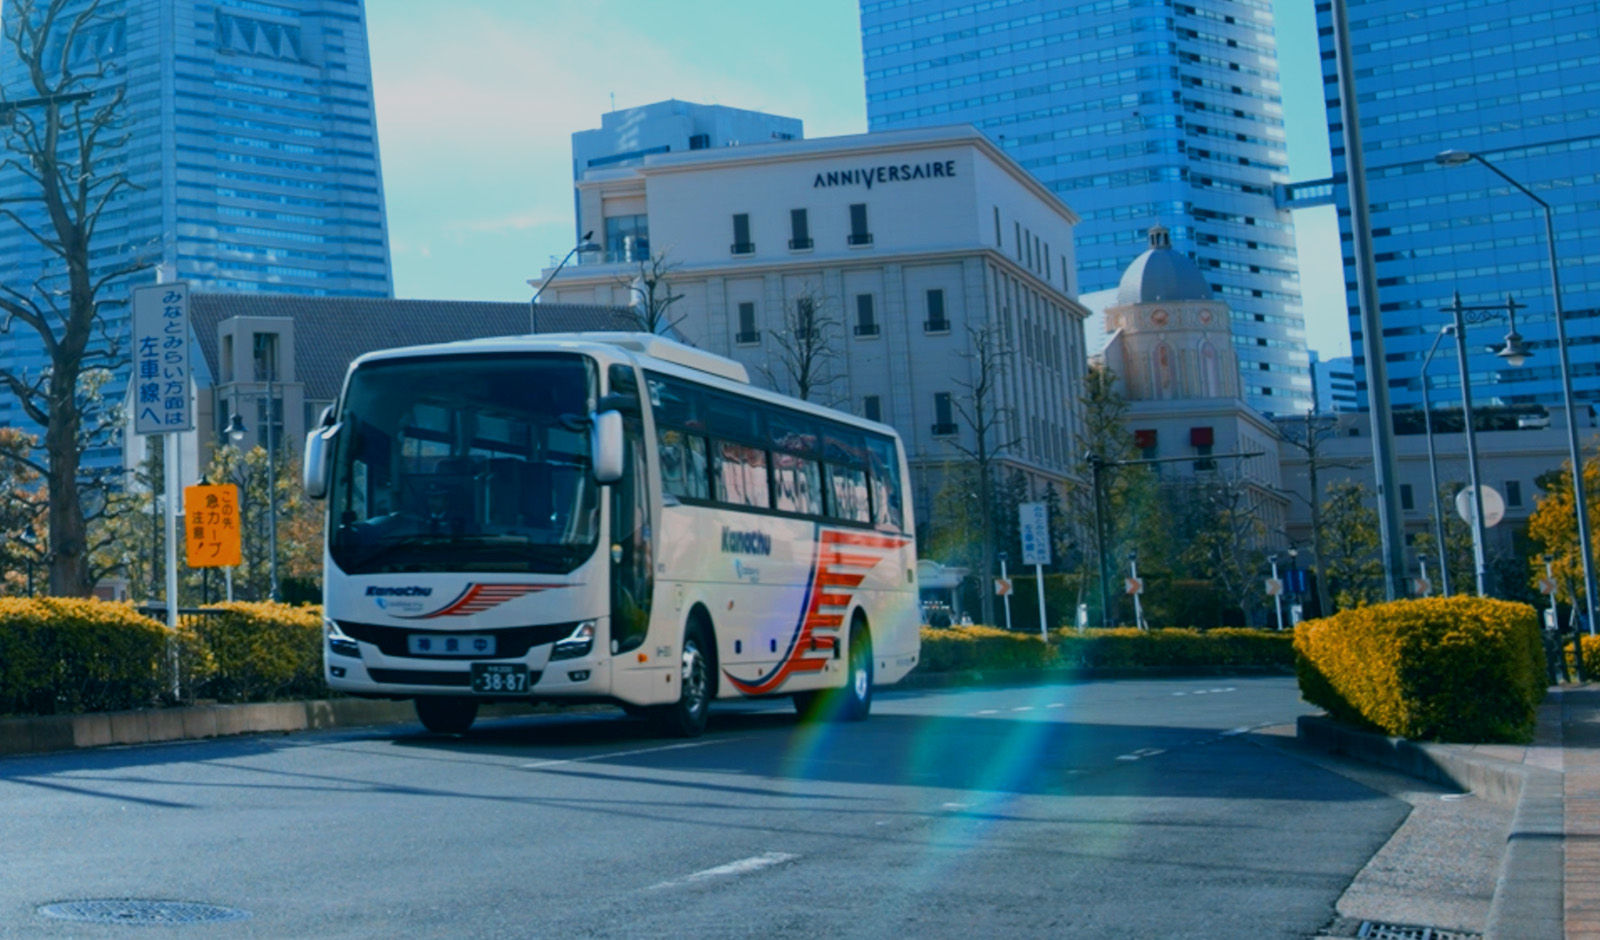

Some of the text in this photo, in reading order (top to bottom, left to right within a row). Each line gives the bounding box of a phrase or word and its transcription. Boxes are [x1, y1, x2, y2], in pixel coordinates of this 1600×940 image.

[813, 160, 957, 190] ANNIVERSAIRE
[139, 336, 161, 425] 左車線へ
[163, 290, 184, 426] みなとみらい方面は
[482, 672, 525, 690] 38-87
